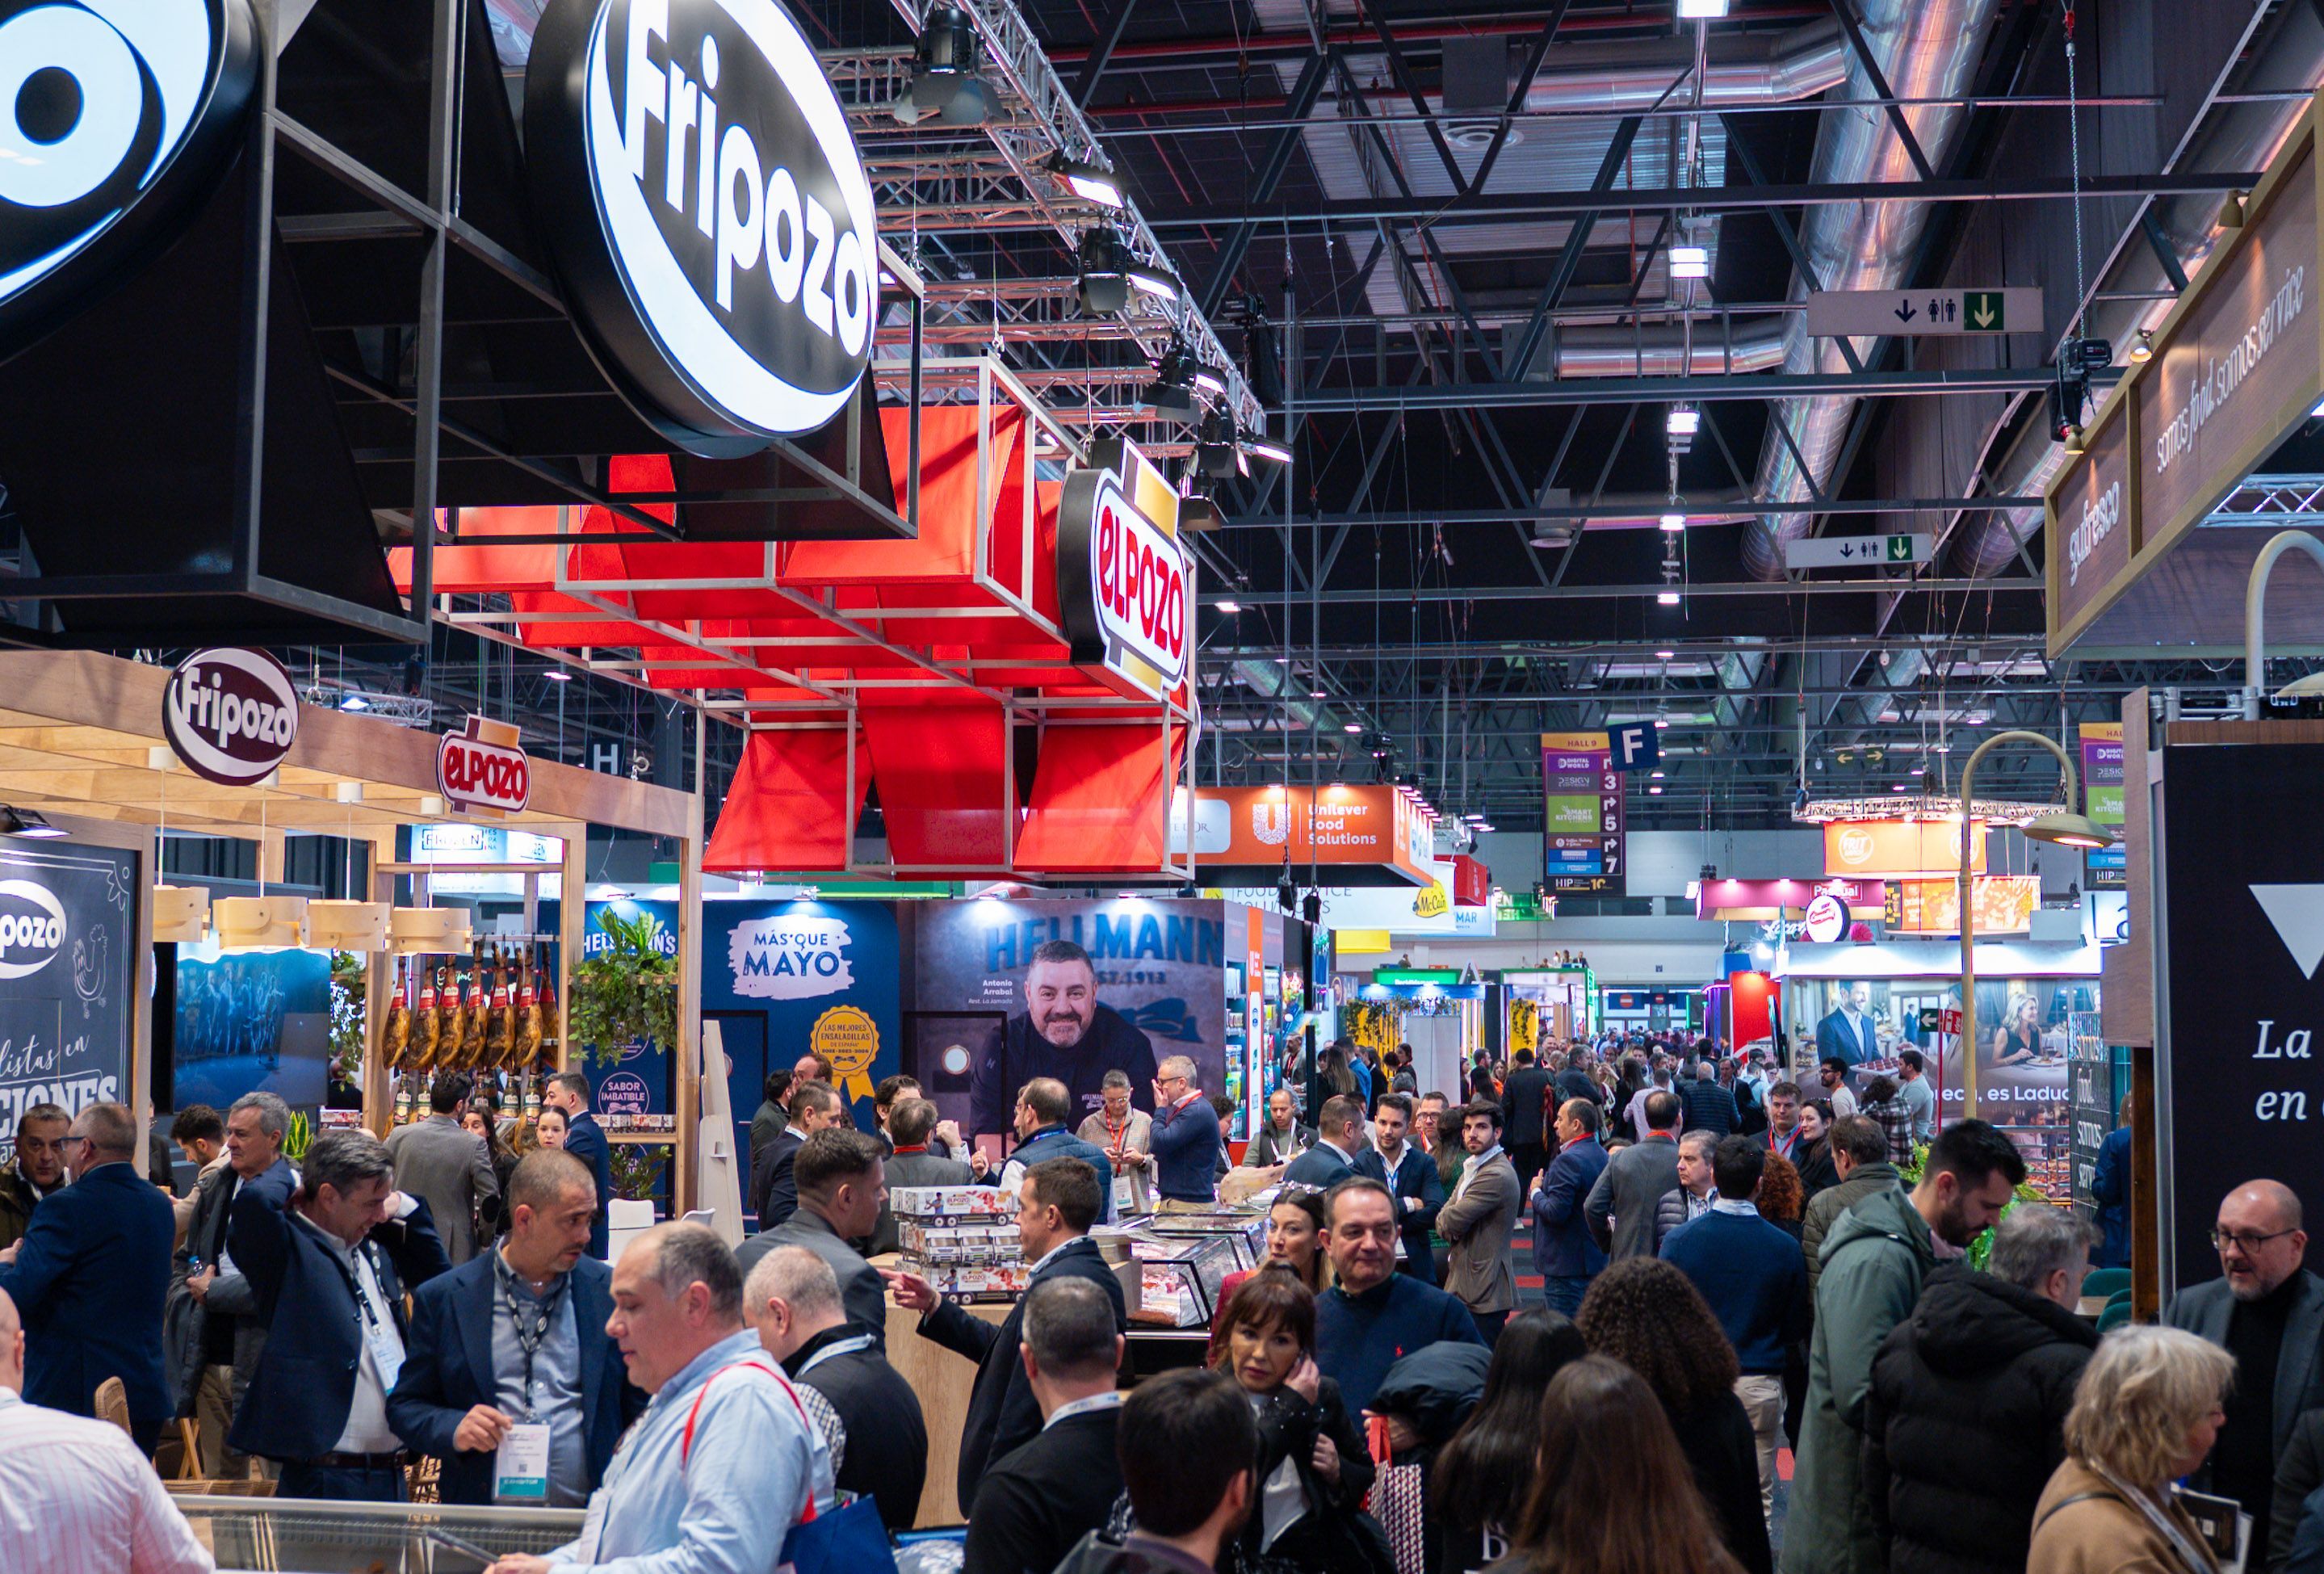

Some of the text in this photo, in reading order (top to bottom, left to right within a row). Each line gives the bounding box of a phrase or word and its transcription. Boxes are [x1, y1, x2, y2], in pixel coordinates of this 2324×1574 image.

[628, 0, 866, 357] Fripozo
[2156, 409, 2188, 474] somos
[2217, 325, 2257, 407] somos
[2257, 265, 2305, 359] service
[180, 666, 292, 748] Fripozo
[1622, 728, 1643, 763] F
[594, 745, 617, 774] H
[1605, 775, 1617, 790] 3
[1308, 804, 1368, 816] Unilever
[1308, 818, 1344, 831] Food
[1605, 816, 1617, 831] 5
[1308, 833, 1377, 846] Solutions
[1605, 858, 1617, 873] 7
[1555, 878, 1574, 888] HIP
[2097, 871, 2115, 880] HIP
[1420, 893, 1446, 913] McCain
[753, 930, 828, 951] MÁS QUE
[742, 951, 840, 977] MAYO
[983, 979, 1013, 987] Antonio
[984, 988, 1013, 996] Arrabal
[66, 1035, 90, 1057] en
[2251, 1020, 2312, 1059] La
[607, 1082, 640, 1091] SABOR
[601, 1093, 645, 1102] IMBATIBLE
[1987, 1089, 2010, 1102] es
[2255, 1091, 2307, 1121] en
